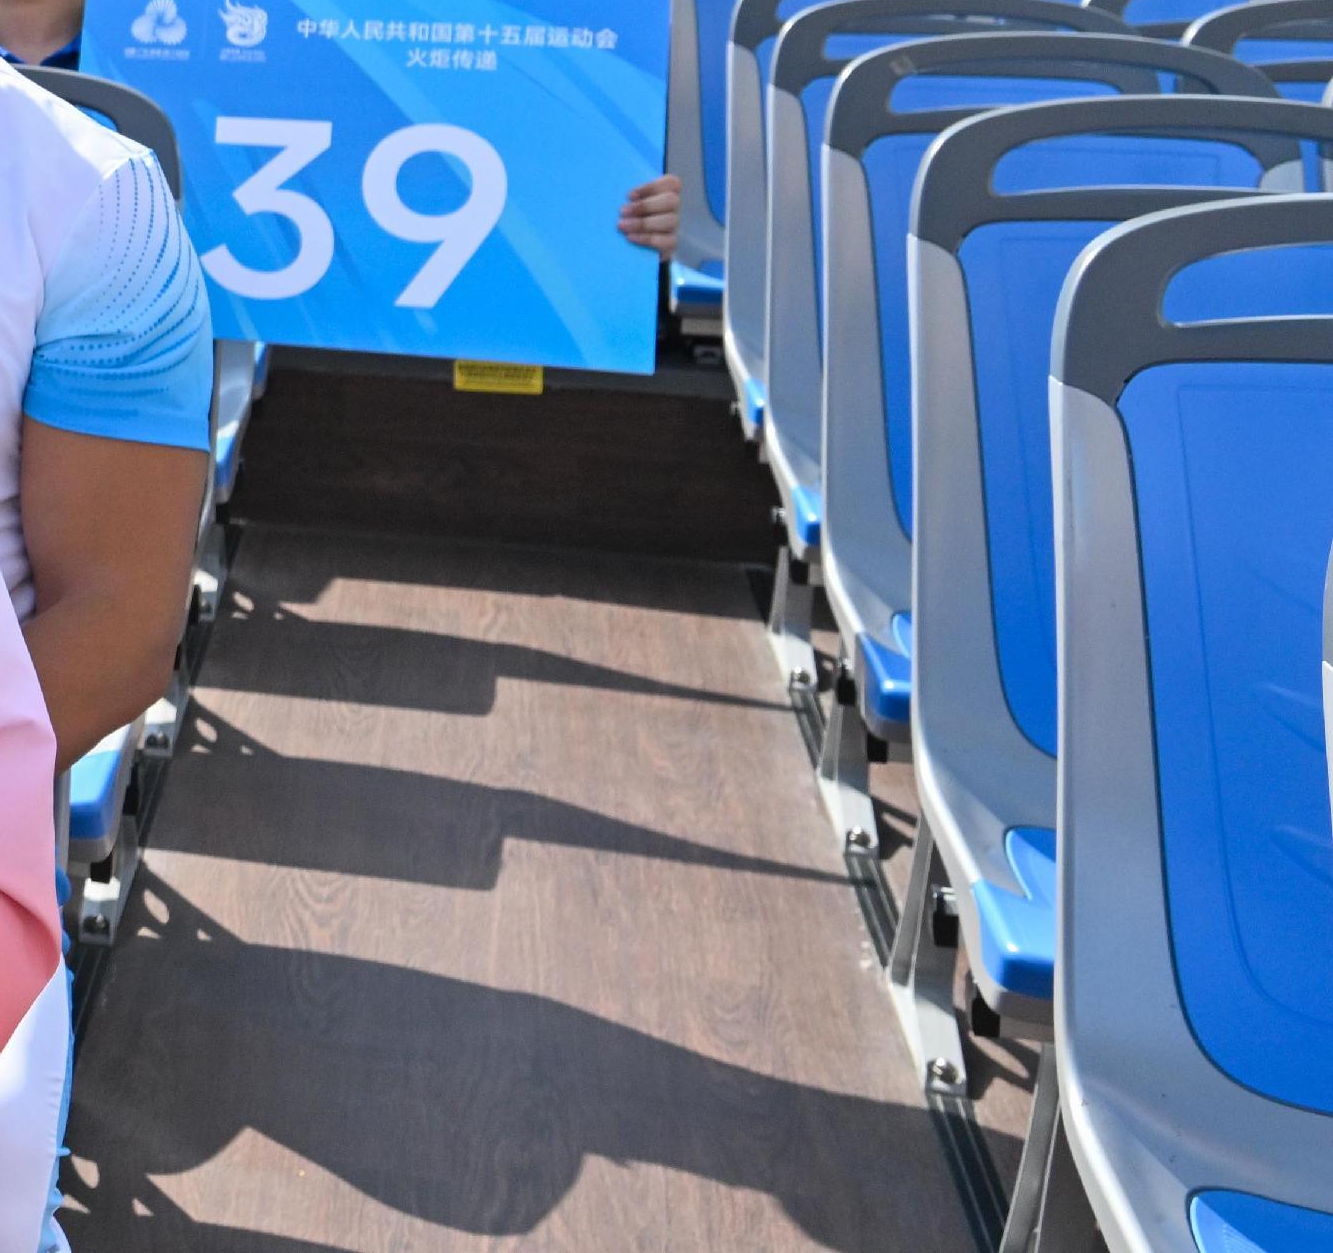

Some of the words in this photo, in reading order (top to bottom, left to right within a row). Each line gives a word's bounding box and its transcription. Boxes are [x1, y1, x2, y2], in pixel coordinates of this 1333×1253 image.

[297, 19, 618, 49] 中华人民共和国第十五届运动会
[406, 48, 497, 71] 火炬传递
[200, 116, 508, 308] 39
